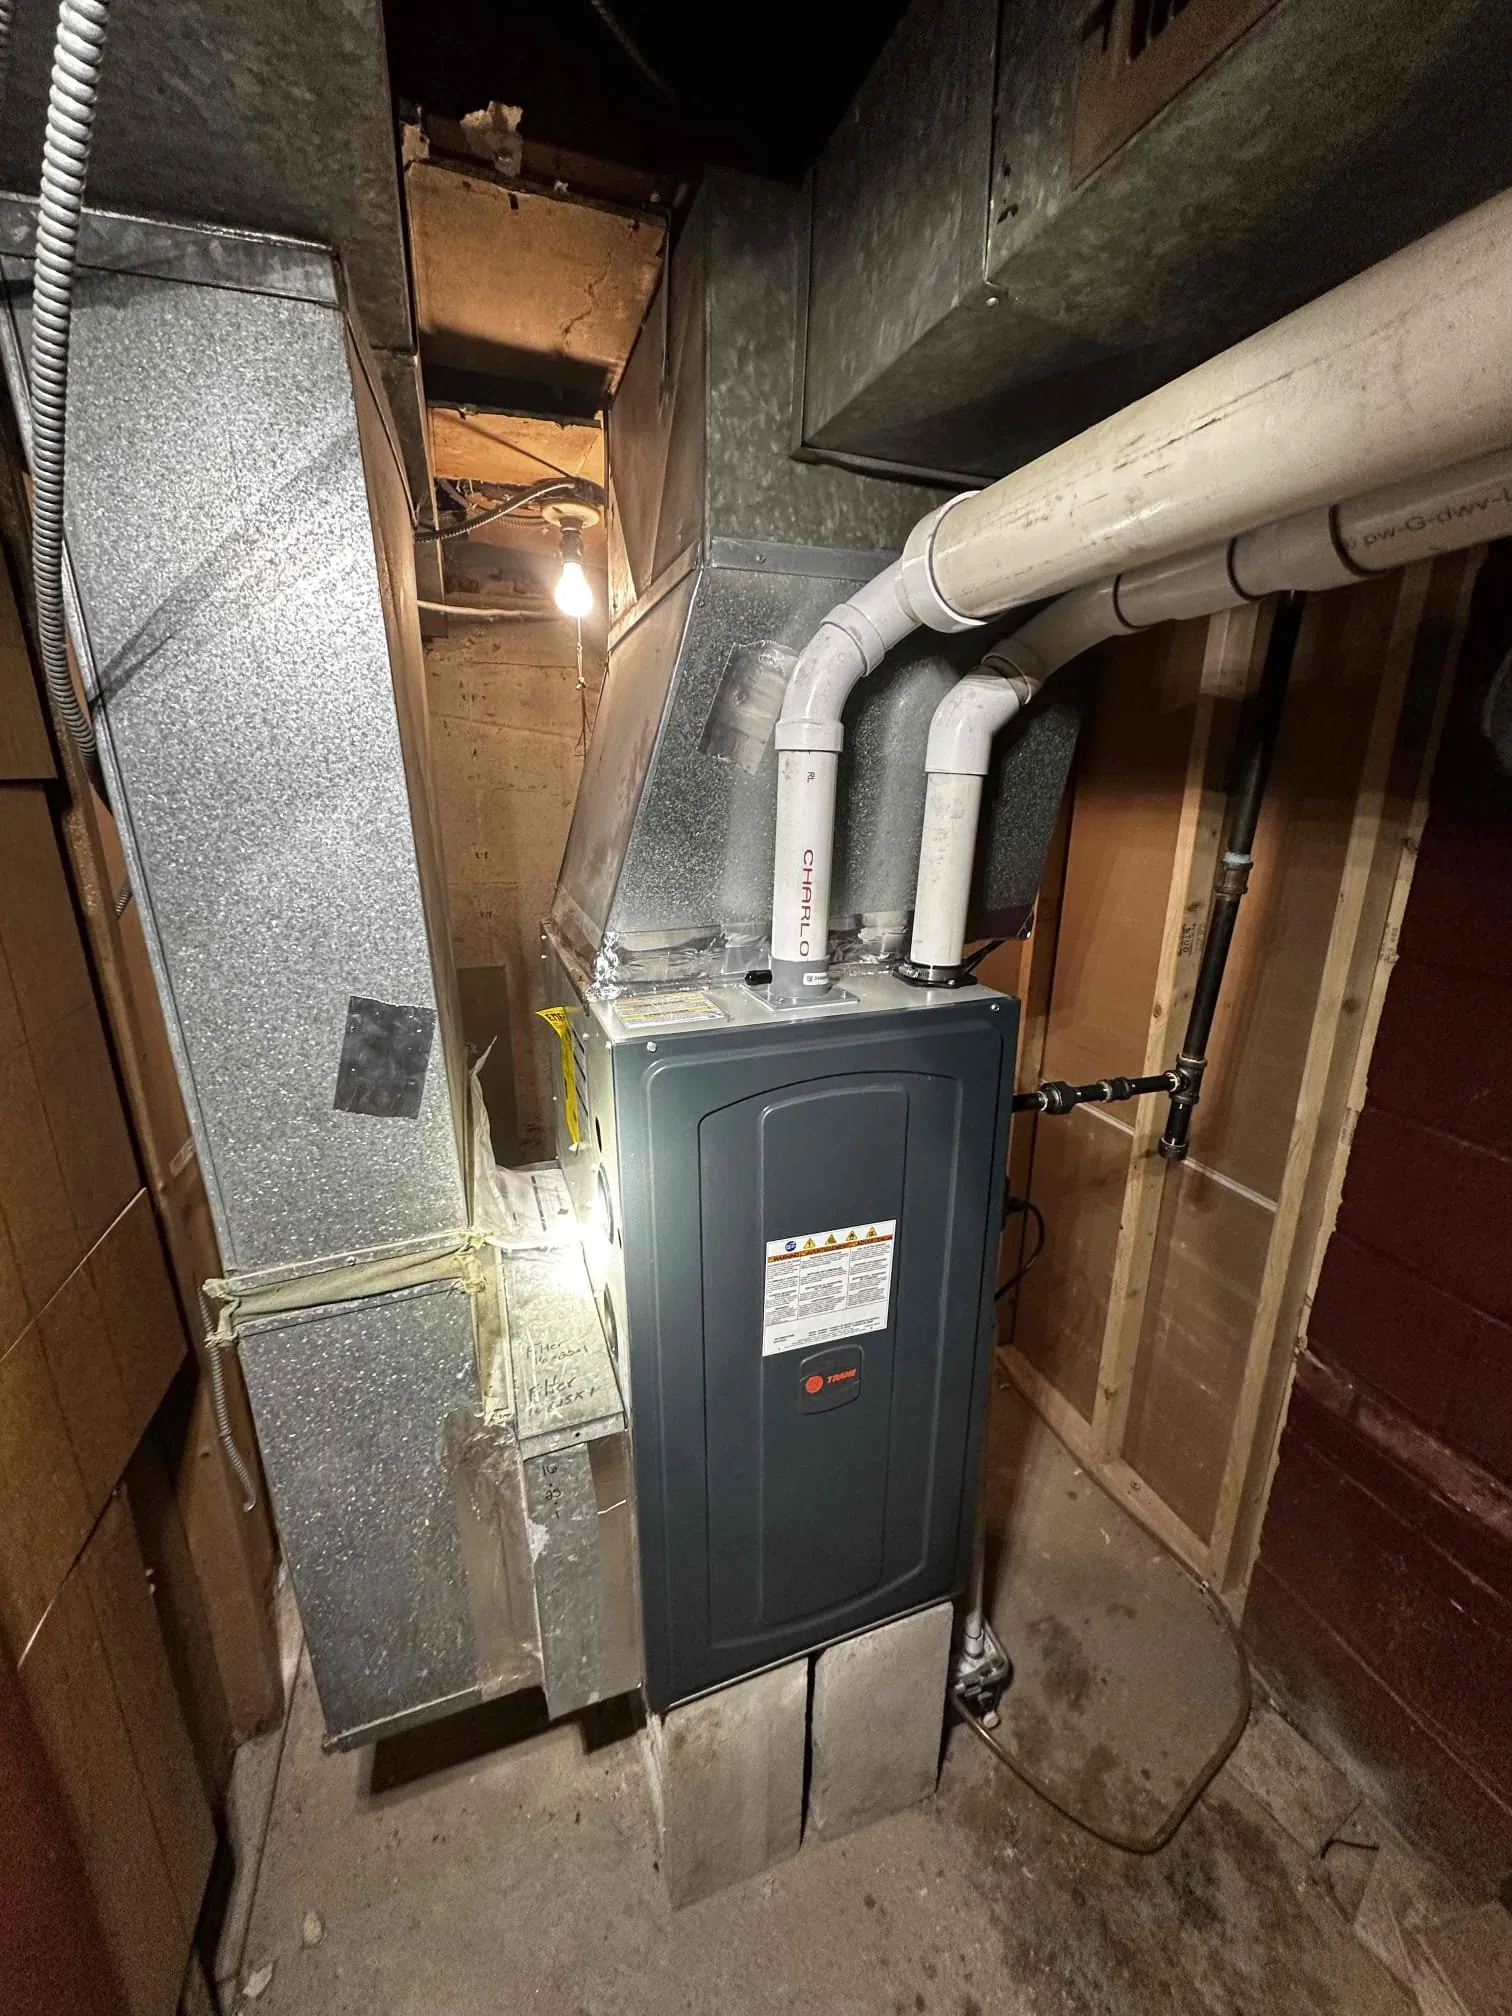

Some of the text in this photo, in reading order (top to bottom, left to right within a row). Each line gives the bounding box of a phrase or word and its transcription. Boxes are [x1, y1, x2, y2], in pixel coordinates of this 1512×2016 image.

[799, 849, 814, 961] CHARLO
[827, 1368, 857, 1384] TRANE
[529, 1374, 577, 1401] Filter
[542, 1465, 558, 1476] 16
